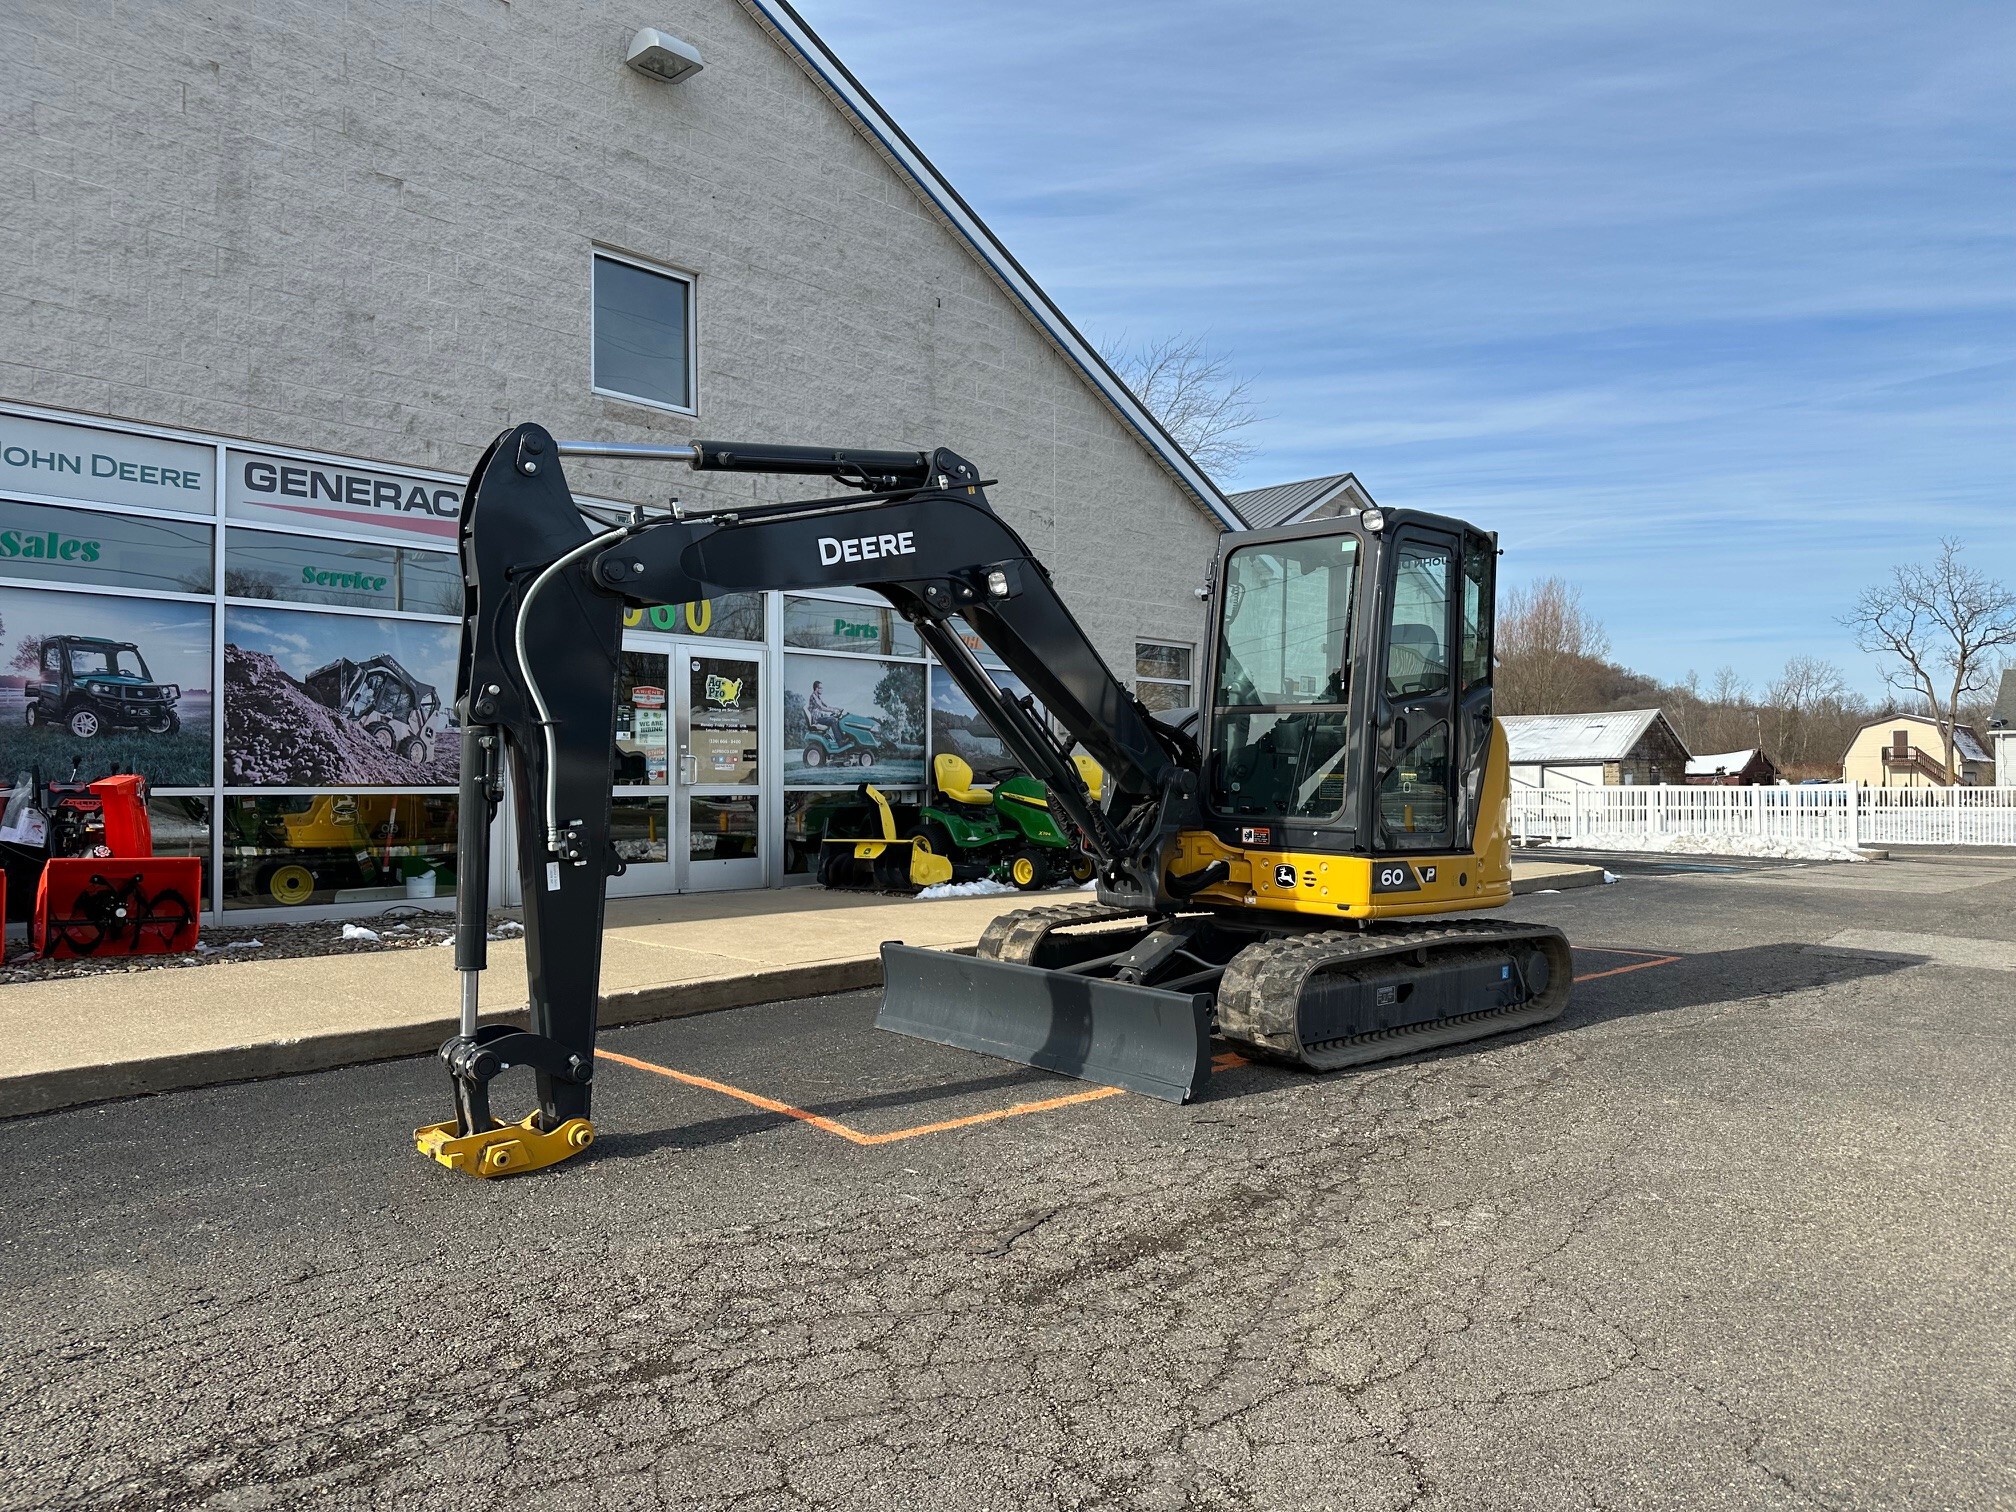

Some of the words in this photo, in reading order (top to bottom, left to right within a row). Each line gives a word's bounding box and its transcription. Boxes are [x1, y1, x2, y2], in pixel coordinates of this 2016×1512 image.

[0, 441, 81, 475] OHN
[92, 453, 201, 491] DEERE
[244, 461, 460, 518] GENERAC
[0, 530, 101, 563] Sales
[818, 531, 916, 566] DEERE
[302, 565, 387, 592] Service
[833, 618, 878, 639] Parts
[708, 687, 726, 698] Pro
[1381, 868, 1404, 886] 60
[1426, 867, 1436, 882] P
